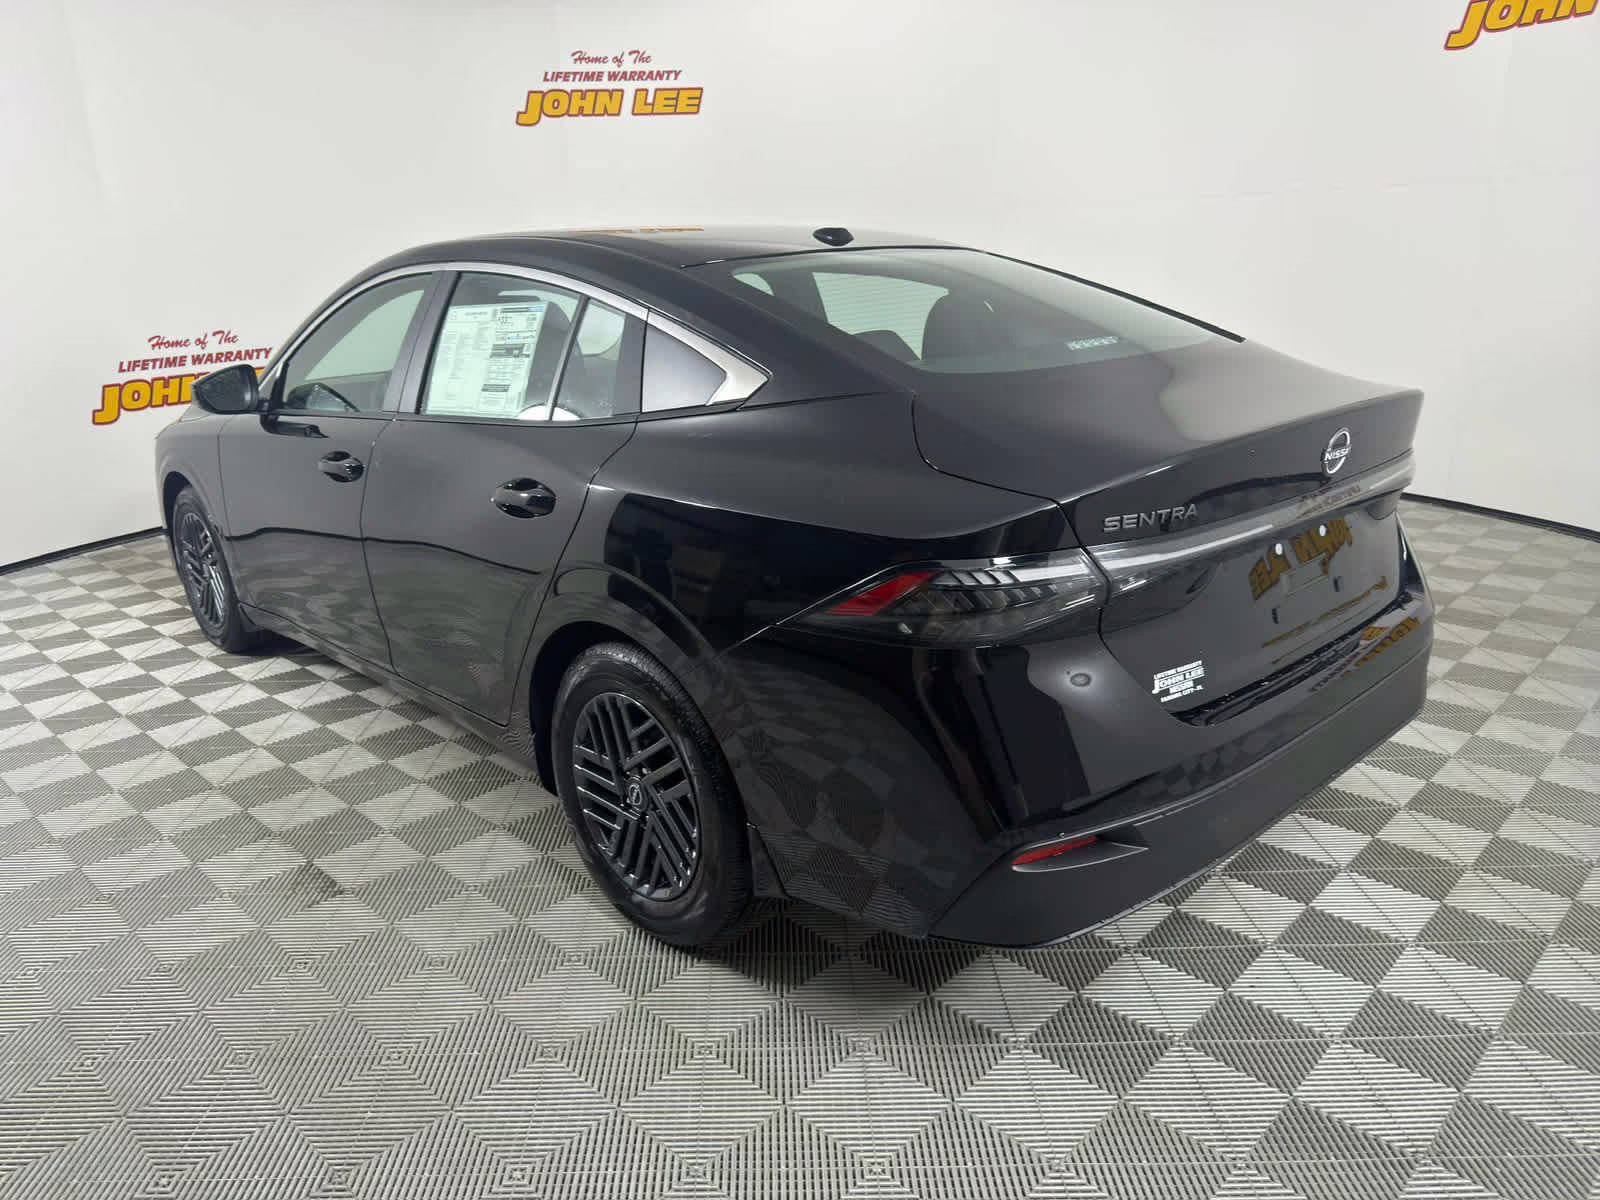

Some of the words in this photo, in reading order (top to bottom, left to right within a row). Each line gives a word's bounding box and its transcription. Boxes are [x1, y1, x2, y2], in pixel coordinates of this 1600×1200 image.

[571, 50, 608, 65] Home
[612, 51, 624, 68] of
[628, 49, 652, 65] The
[543, 71, 604, 82] LIFETIME
[607, 70, 682, 82] WARRANTY
[516, 88, 624, 126] JOHN
[632, 87, 703, 116] LEE
[148, 335, 190, 350] Home
[194, 333, 208, 349] of
[212, 330, 239, 345] The
[118, 354, 188, 373] LIFETIME
[191, 347, 272, 366] WARRANTY
[1103, 503, 1198, 533] SENTRA
[1152, 674, 1184, 694] JOHN
[1185, 667, 1204, 680] LEE
